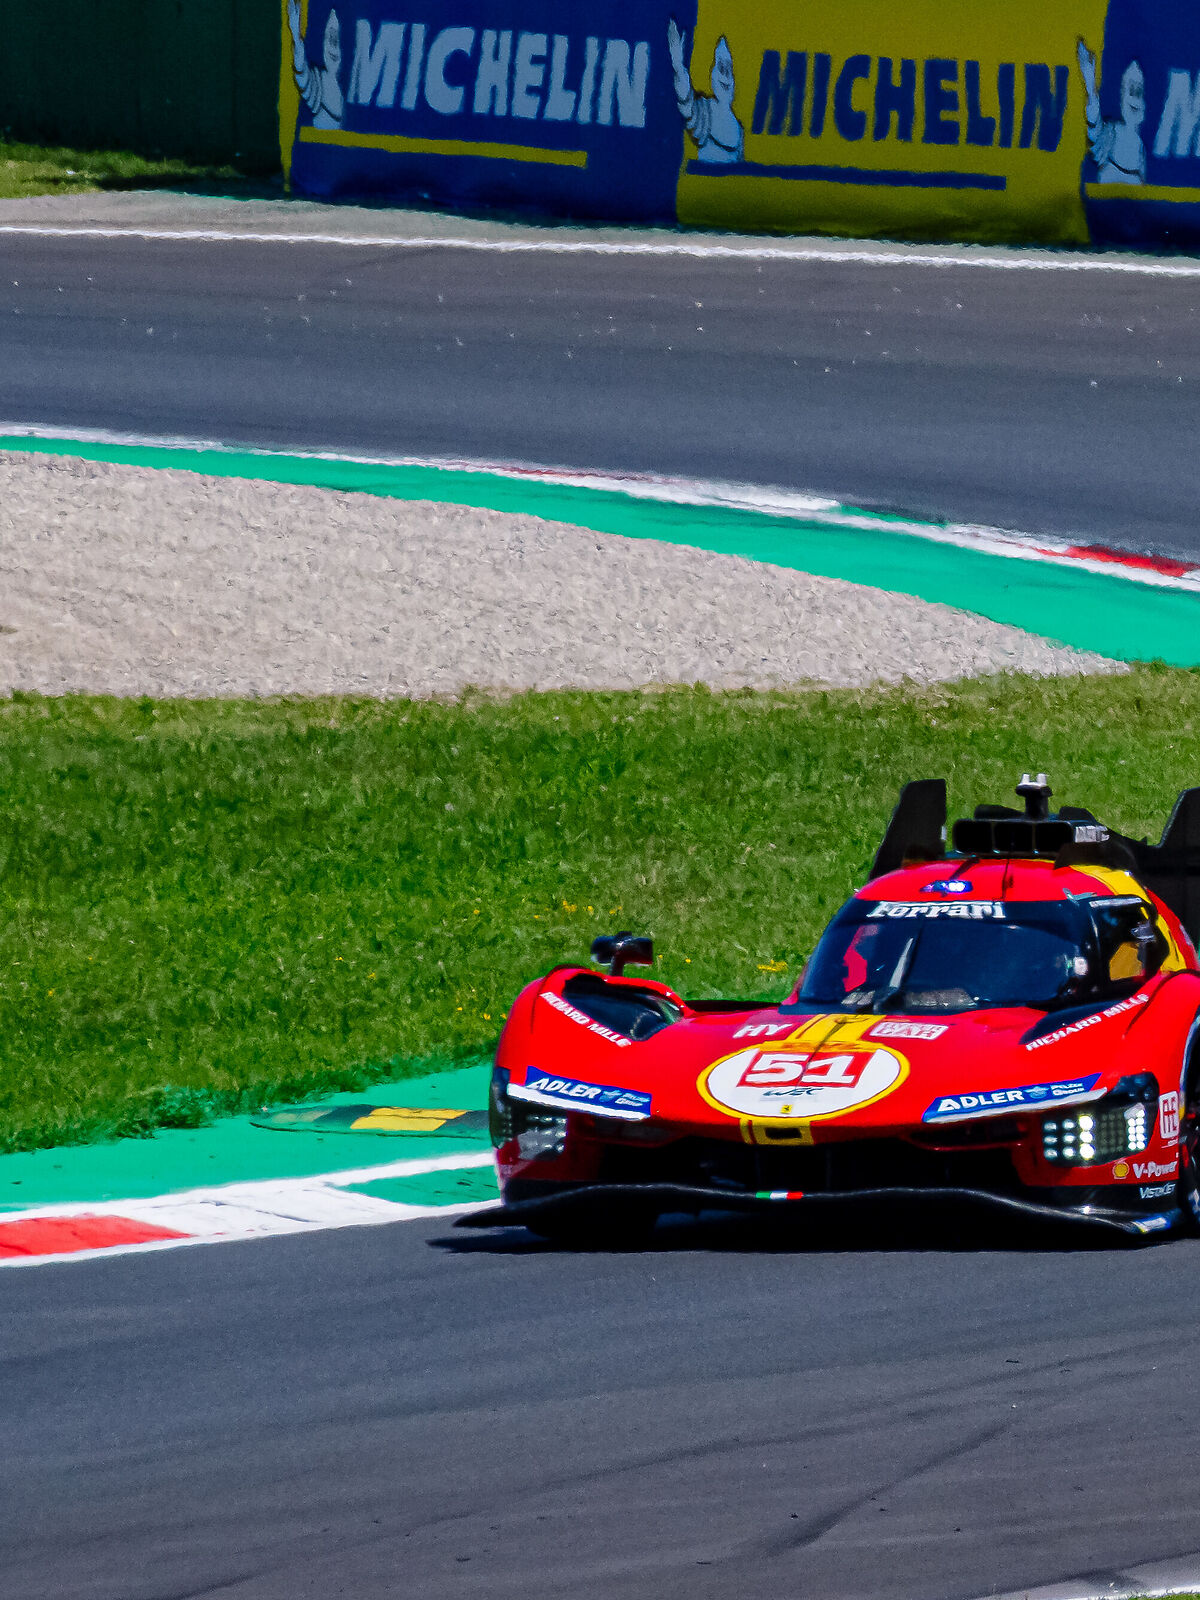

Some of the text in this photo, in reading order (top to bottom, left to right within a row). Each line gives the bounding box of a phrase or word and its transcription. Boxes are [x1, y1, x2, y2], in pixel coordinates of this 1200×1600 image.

[347, 19, 651, 129] MICHELIN
[750, 48, 1069, 153] MICHELIN
[866, 900, 1006, 919] Ferrari
[732, 1023, 793, 1038] HY
[1026, 1015, 1102, 1051] RICHARD
[745, 1053, 855, 1084] 51
[526, 1078, 601, 1099] ADLER
[937, 1090, 1024, 1112] ADLER
